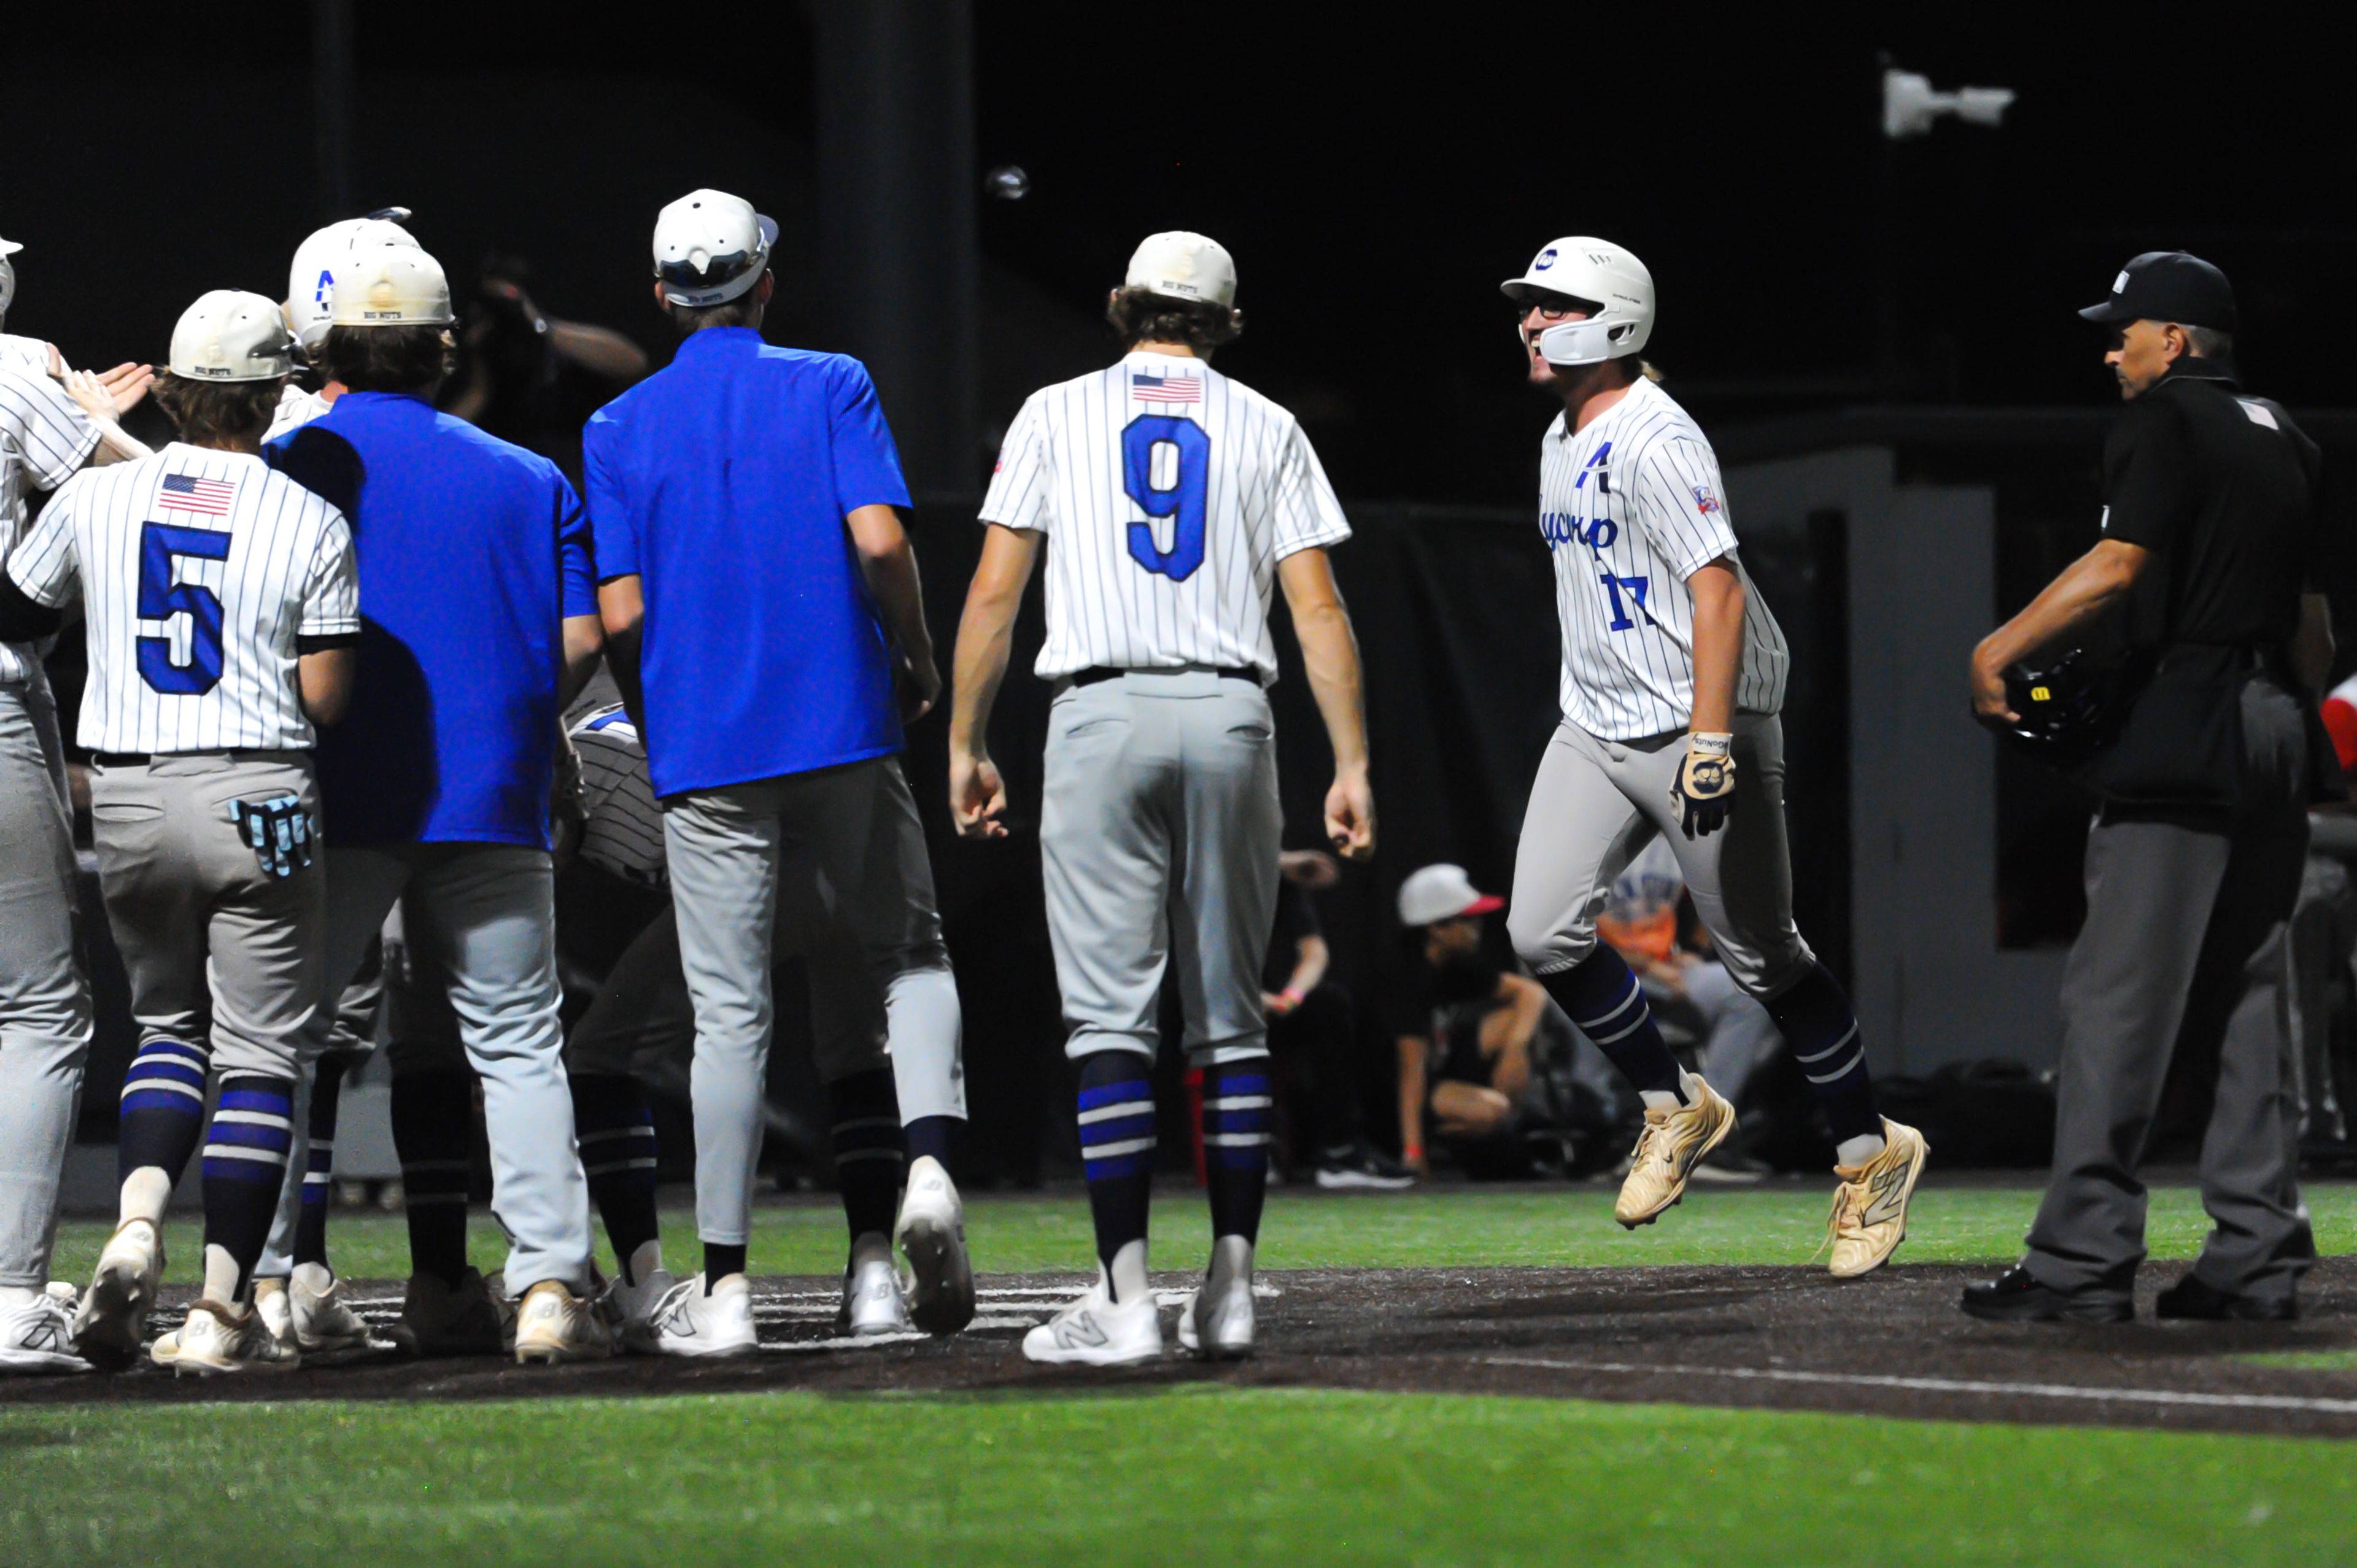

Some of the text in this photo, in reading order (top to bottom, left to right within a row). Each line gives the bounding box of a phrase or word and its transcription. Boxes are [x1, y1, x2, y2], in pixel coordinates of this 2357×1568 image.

[1121, 414, 1211, 582] 9
[136, 521, 233, 697] 5
[1600, 573, 1657, 632] 17
